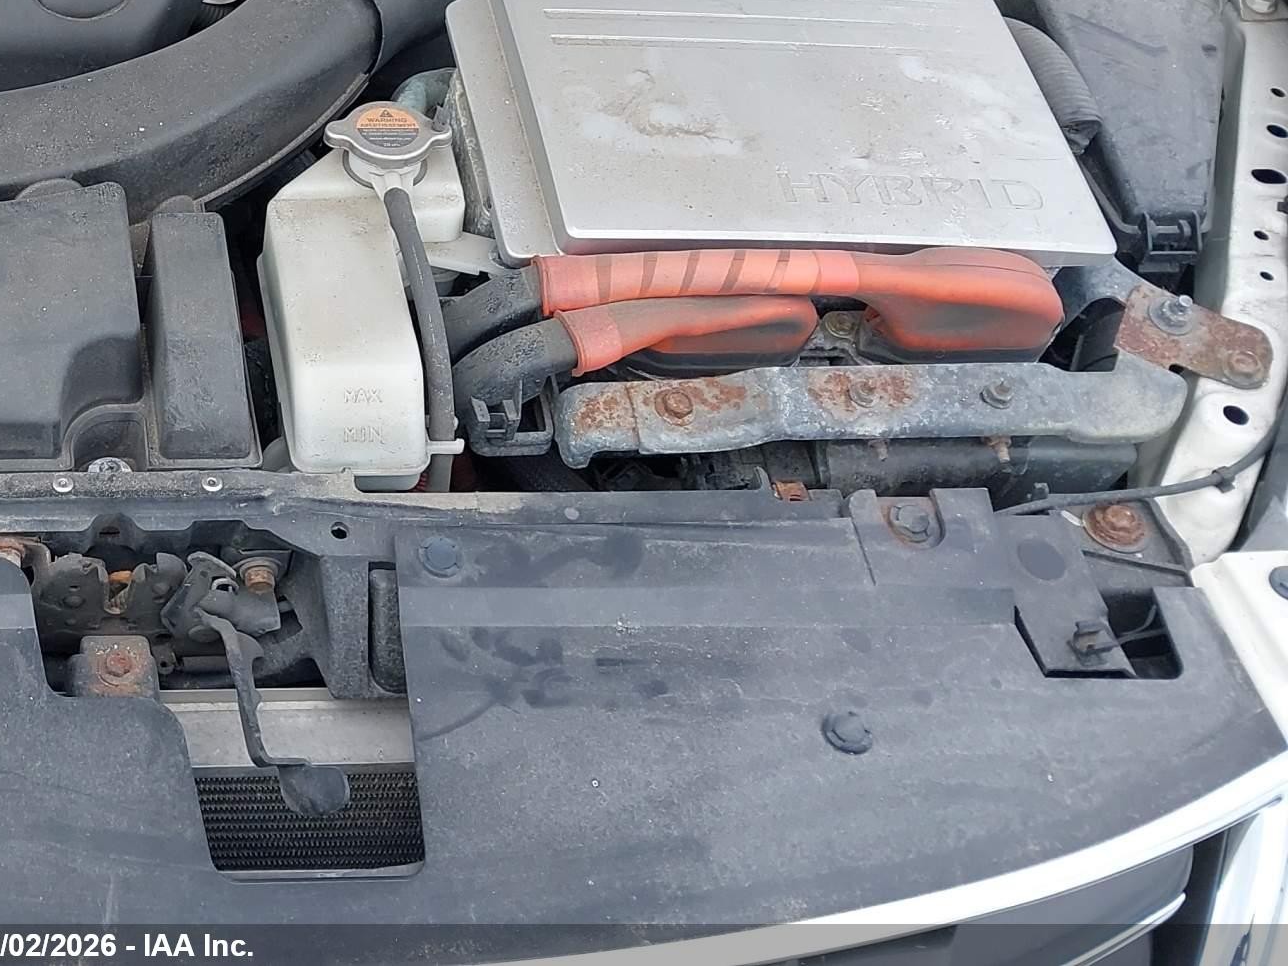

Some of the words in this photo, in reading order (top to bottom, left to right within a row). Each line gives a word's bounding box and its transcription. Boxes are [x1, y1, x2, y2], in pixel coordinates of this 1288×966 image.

[775, 170, 1044, 210] HYBRID
[344, 386, 384, 404] MAX
[344, 425, 385, 444] MIN
